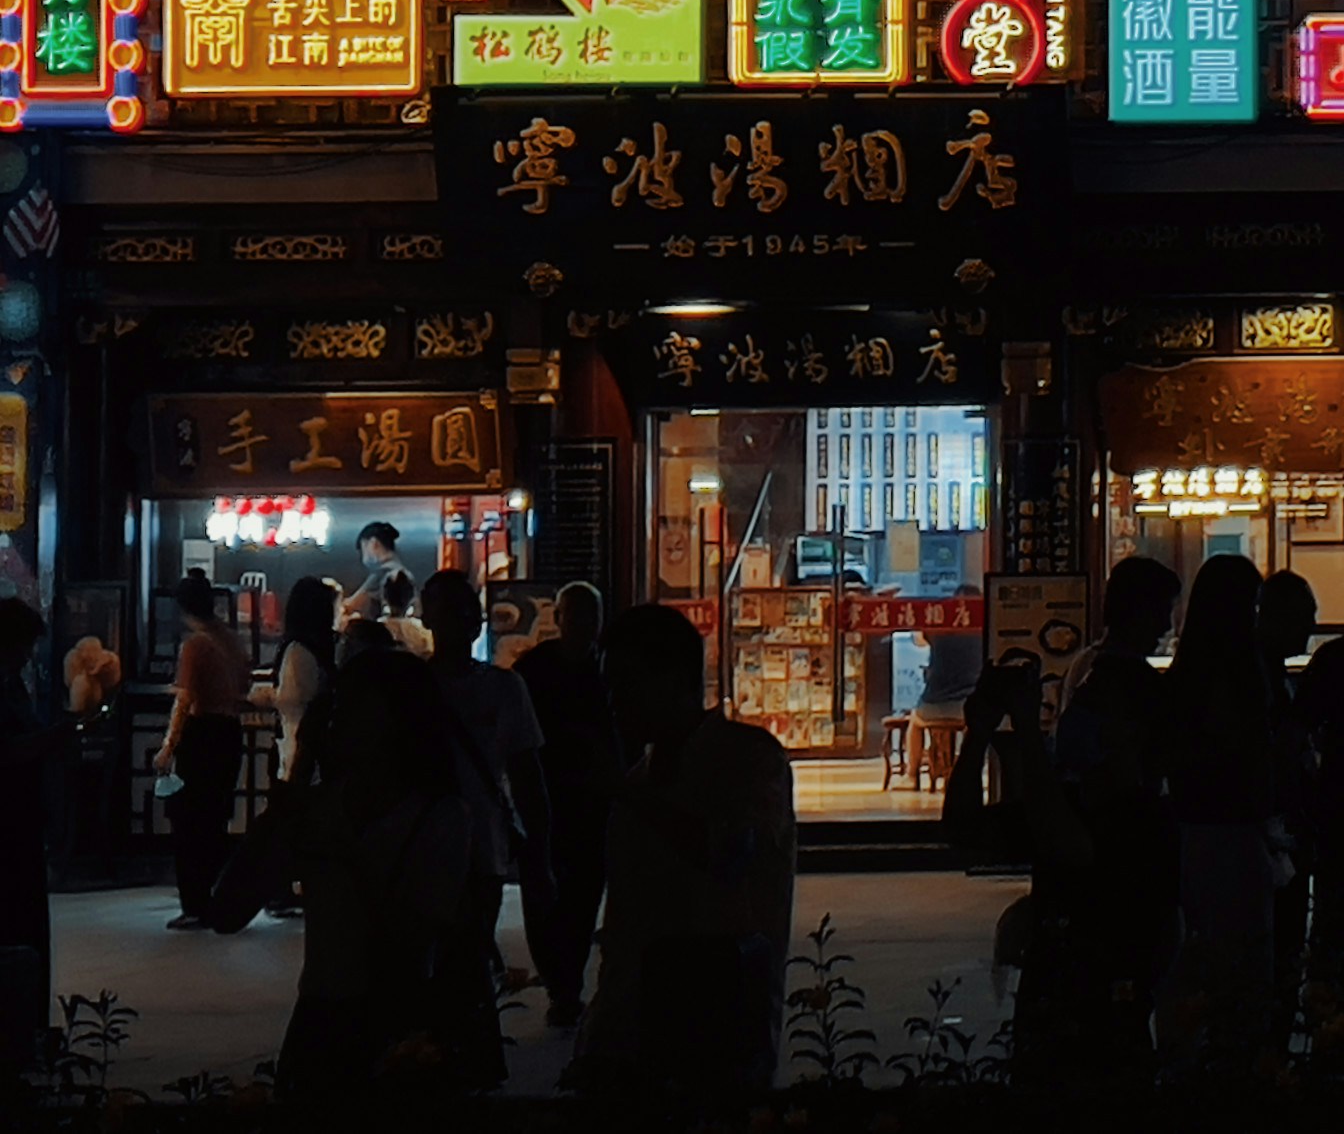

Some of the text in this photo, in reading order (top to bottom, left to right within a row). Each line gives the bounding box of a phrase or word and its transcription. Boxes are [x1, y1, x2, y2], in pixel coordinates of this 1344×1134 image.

[267, 32, 331, 66] 江南
[1045, 5, 1068, 68] TANG
[216, 407, 484, 474] 手工湯圓
